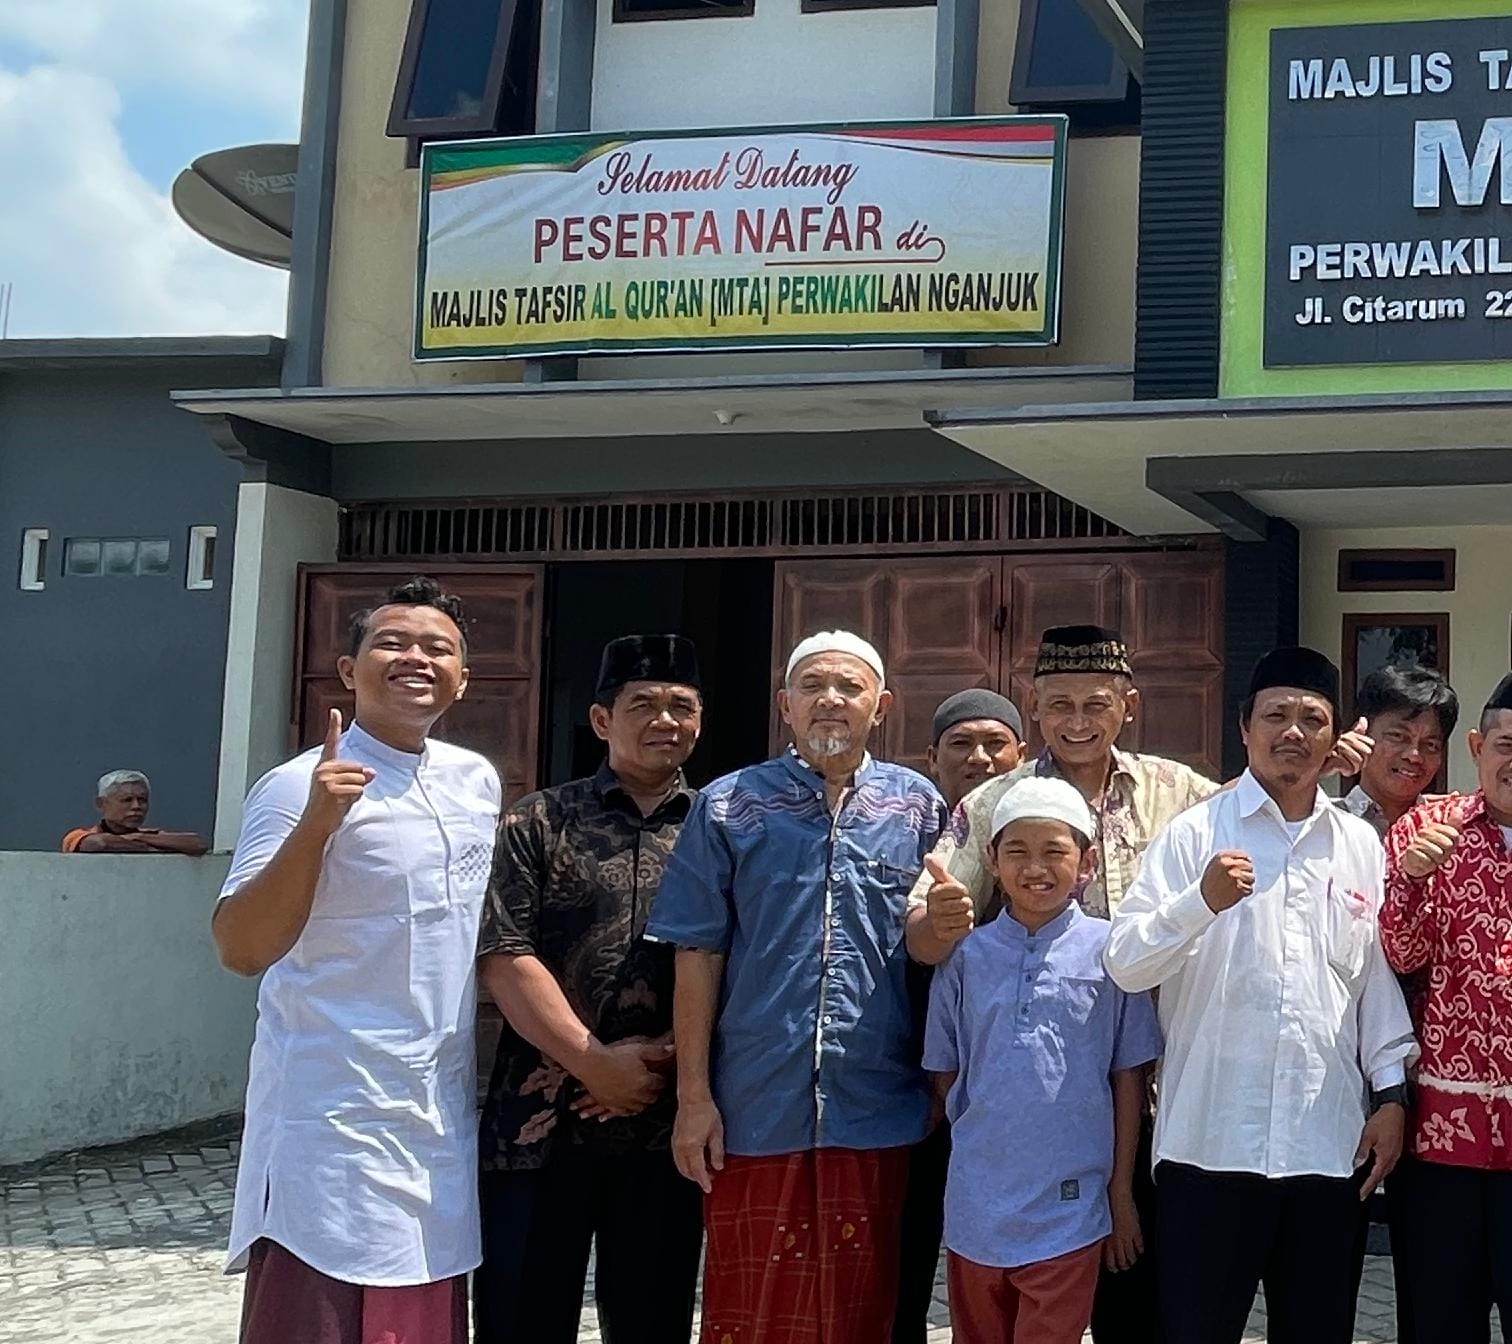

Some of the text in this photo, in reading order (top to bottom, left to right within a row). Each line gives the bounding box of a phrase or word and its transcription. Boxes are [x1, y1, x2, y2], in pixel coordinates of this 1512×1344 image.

[1287, 52, 1453, 100] MAJLIS
[597, 146, 860, 206] Selamat Datang
[533, 210, 722, 264] PESERTA
[734, 205, 883, 255] NAFAR
[430, 289, 508, 328] MAJLIS
[514, 284, 587, 325] TAFSIR
[590, 280, 617, 320] AL
[624, 278, 704, 323] QUR'AN
[776, 272, 921, 315] PERWAKILAN
[928, 271, 1041, 313] NGANJUK
[1294, 296, 1333, 326] Jl.
[1341, 293, 1465, 323] Citarum
